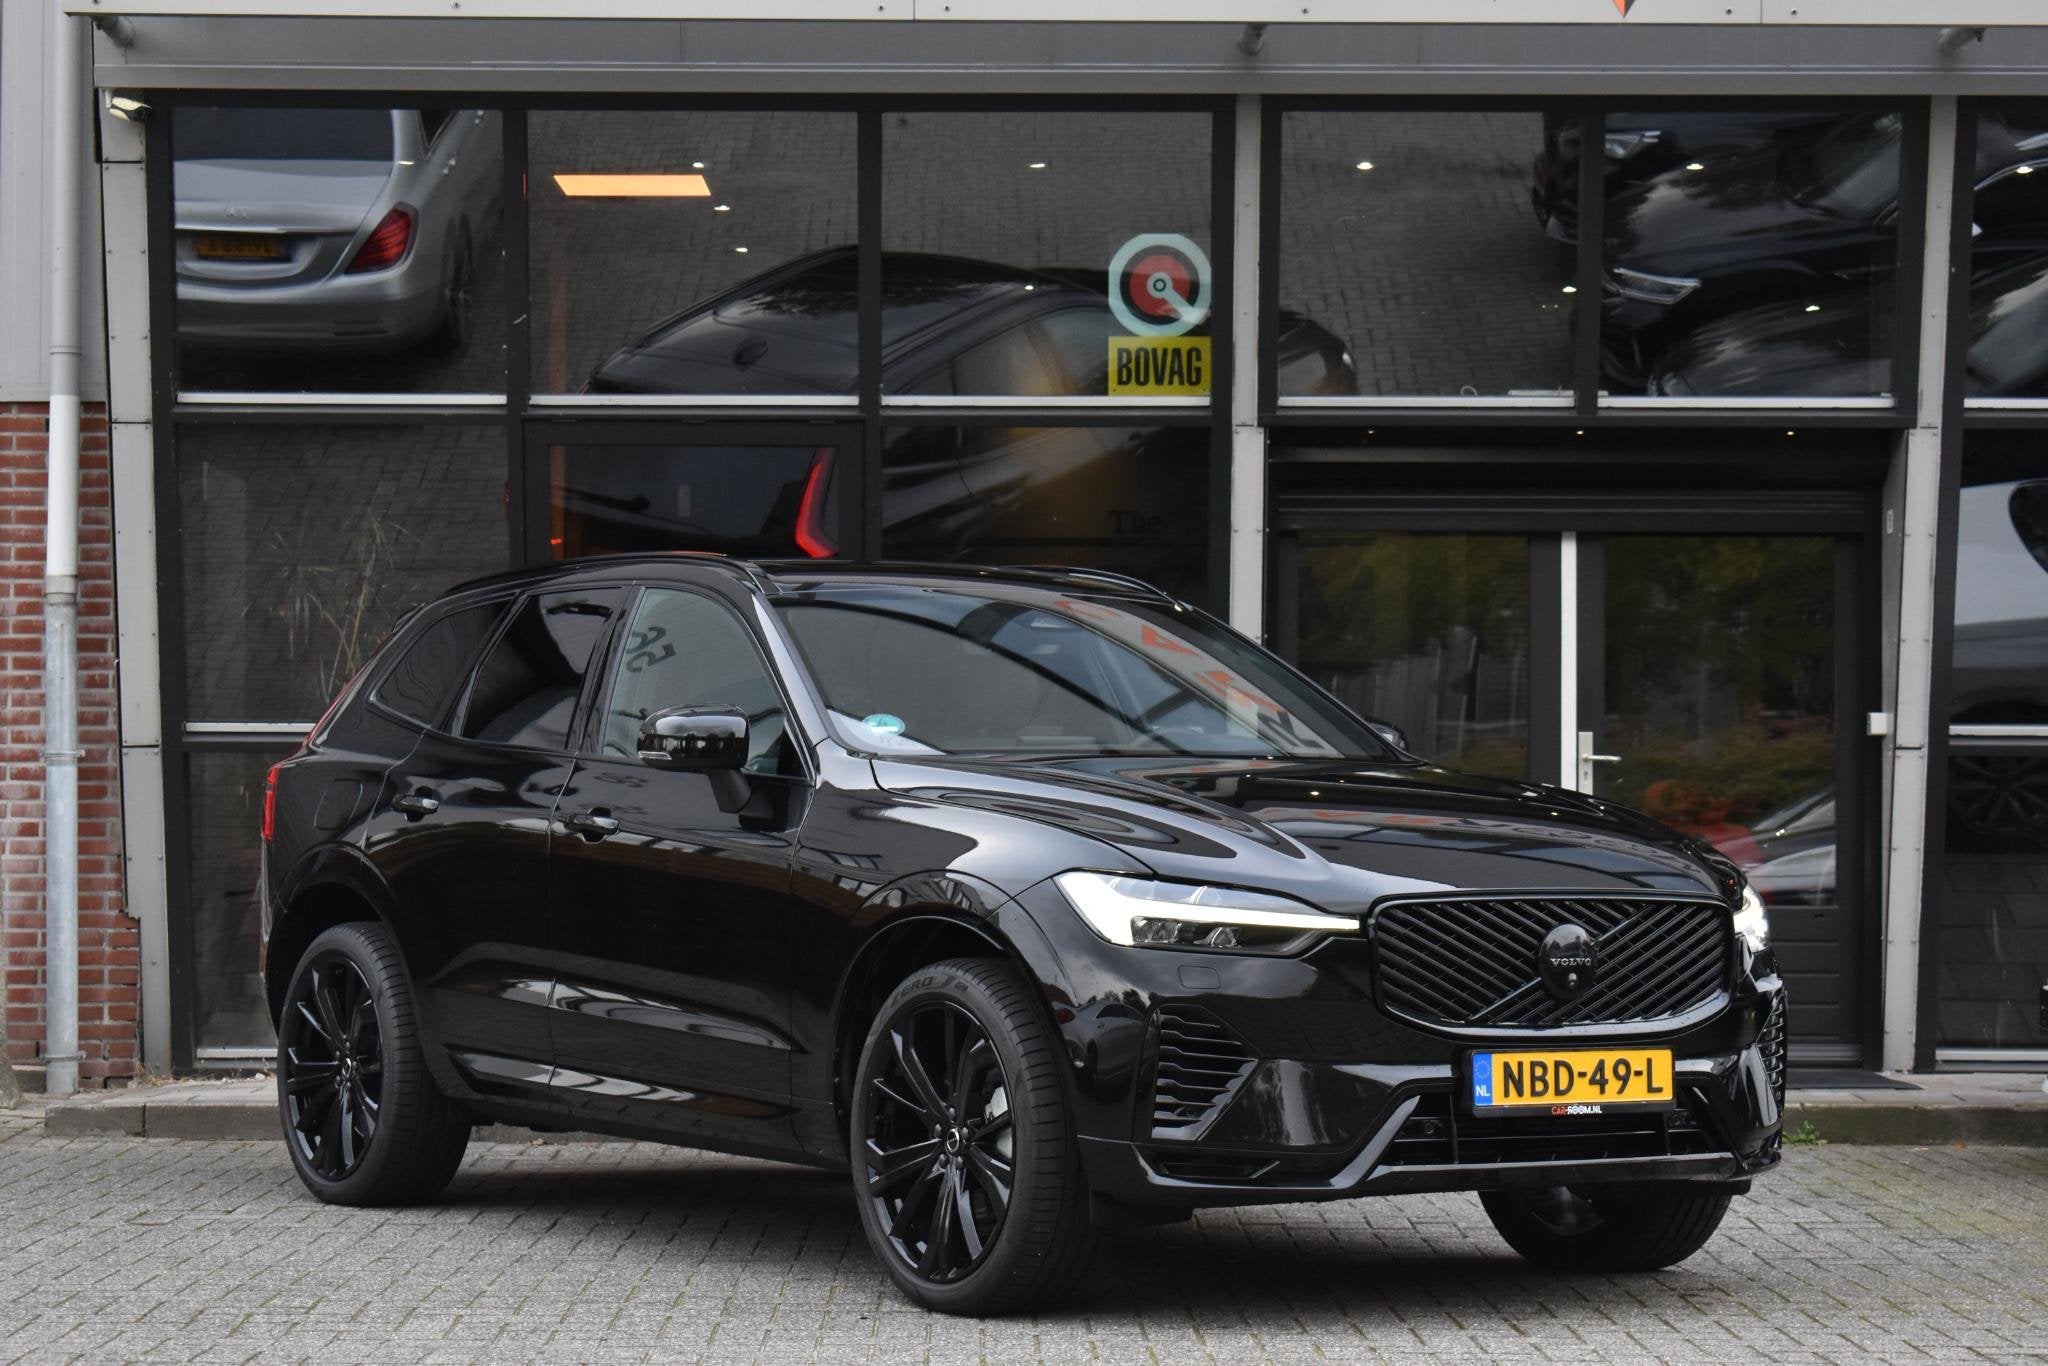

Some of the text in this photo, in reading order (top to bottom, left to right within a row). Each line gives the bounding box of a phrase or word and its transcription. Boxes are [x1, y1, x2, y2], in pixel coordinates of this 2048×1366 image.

[1117, 347, 1202, 387] BOVAG
[1550, 957, 1592, 967] VOLVO
[1503, 1057, 1664, 1098] NBD-49-L
[1475, 1085, 1491, 1097] NL
